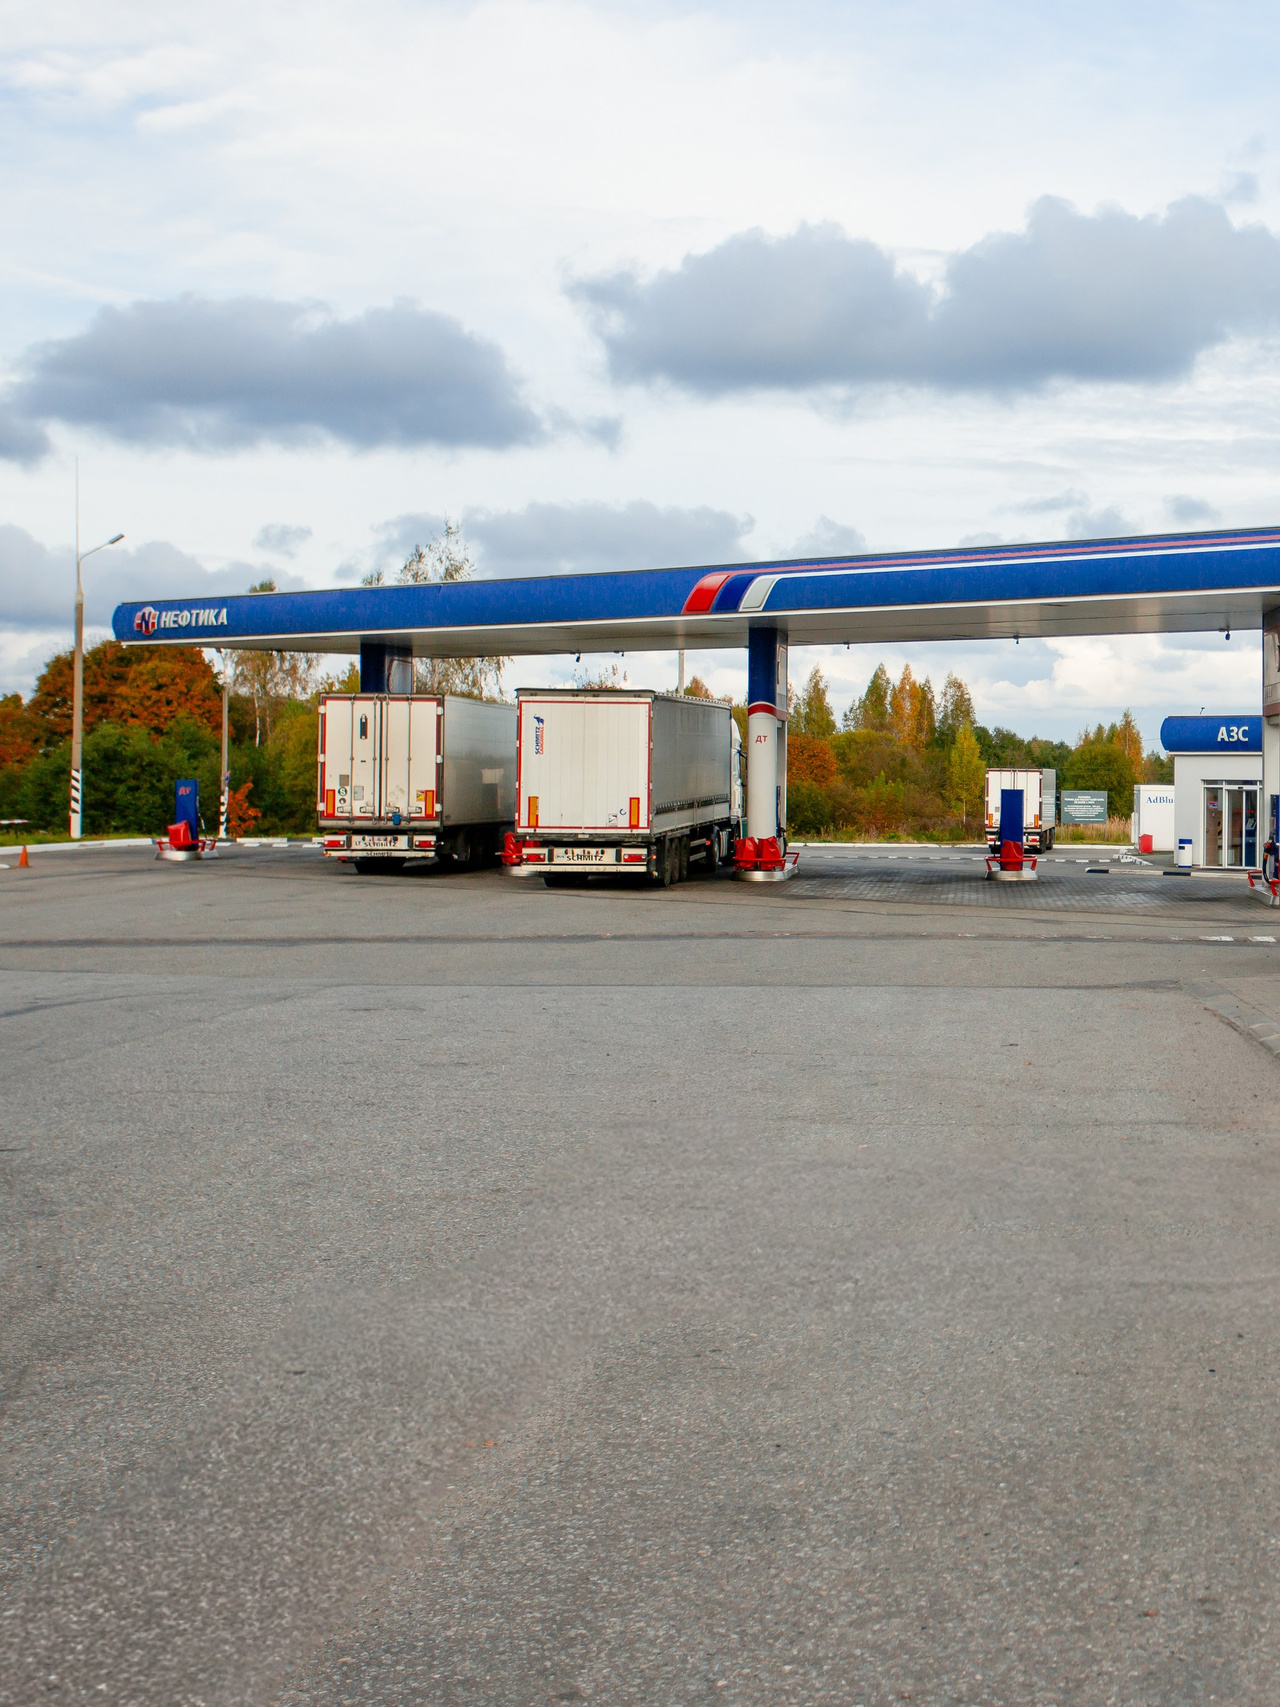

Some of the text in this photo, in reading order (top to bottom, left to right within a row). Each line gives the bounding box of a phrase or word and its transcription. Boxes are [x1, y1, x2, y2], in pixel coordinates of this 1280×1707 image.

[159, 607, 228, 628] НЕФТИКА
[755, 735, 768, 743] ДТ
[1217, 725, 1249, 742] АЗС
[1145, 796, 1174, 804] AdBlu
